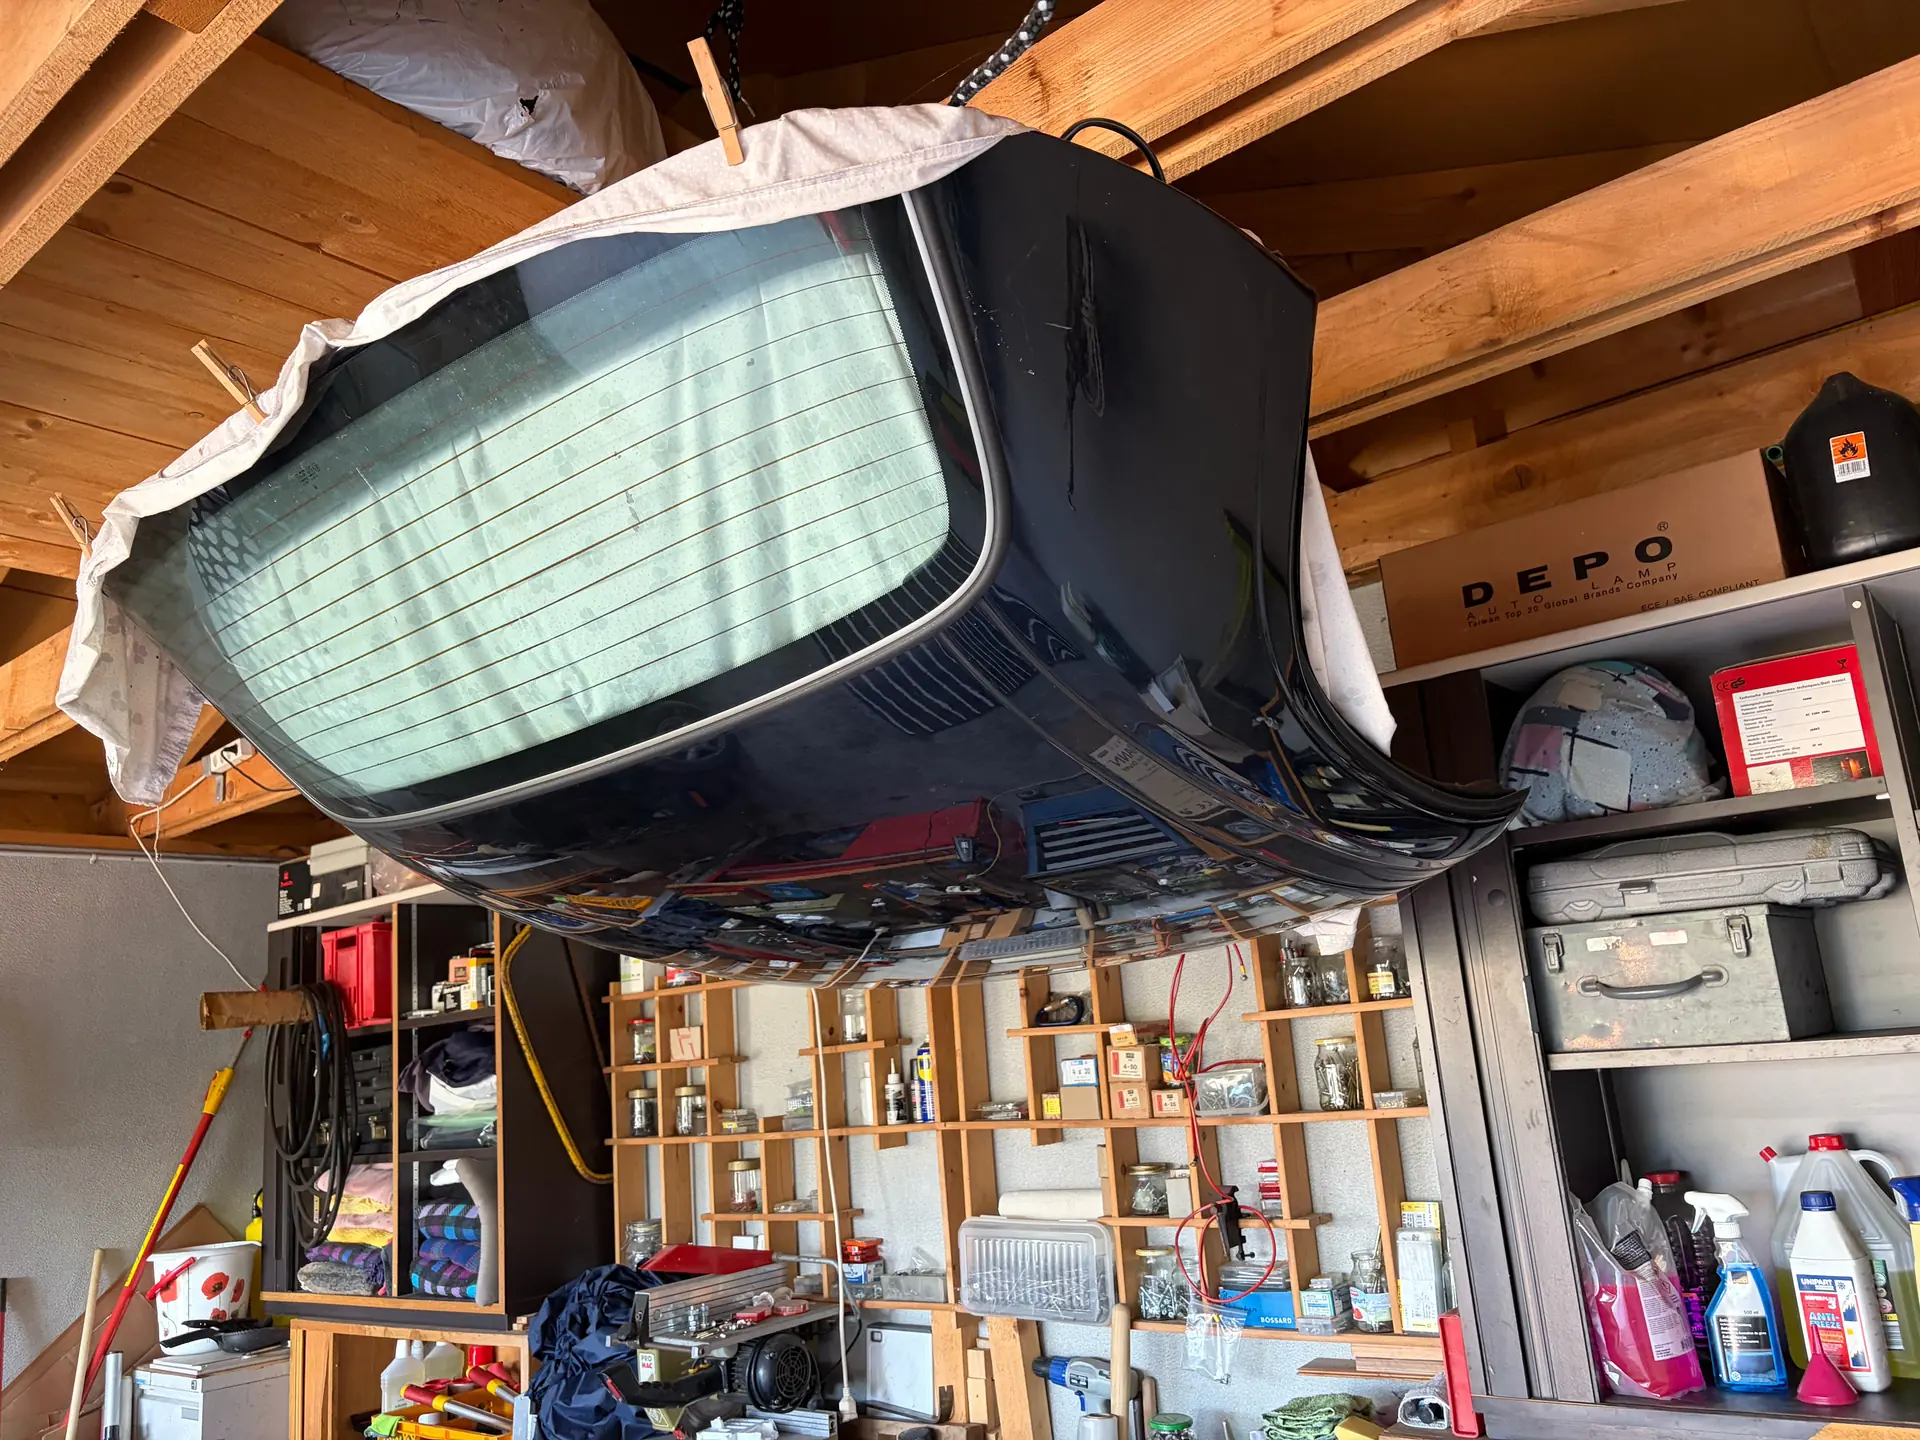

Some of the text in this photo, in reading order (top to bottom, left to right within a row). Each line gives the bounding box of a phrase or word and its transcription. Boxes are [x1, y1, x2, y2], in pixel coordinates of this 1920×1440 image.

[1462, 536, 1673, 608] DEPO
[1467, 562, 1676, 620] AUTO LAMP
[1468, 572, 1678, 628] Taiwan Top 20 Global Brands Company
[1641, 601, 1661, 612] ECE
[1674, 593, 1693, 604] SAE
[1698, 579, 1760, 598] COMPLIANT
[1800, 1277, 1833, 1286] UNIPART
[1260, 1316, 1293, 1325] BOSSARD
[1810, 1320, 1843, 1330] FREEZE
